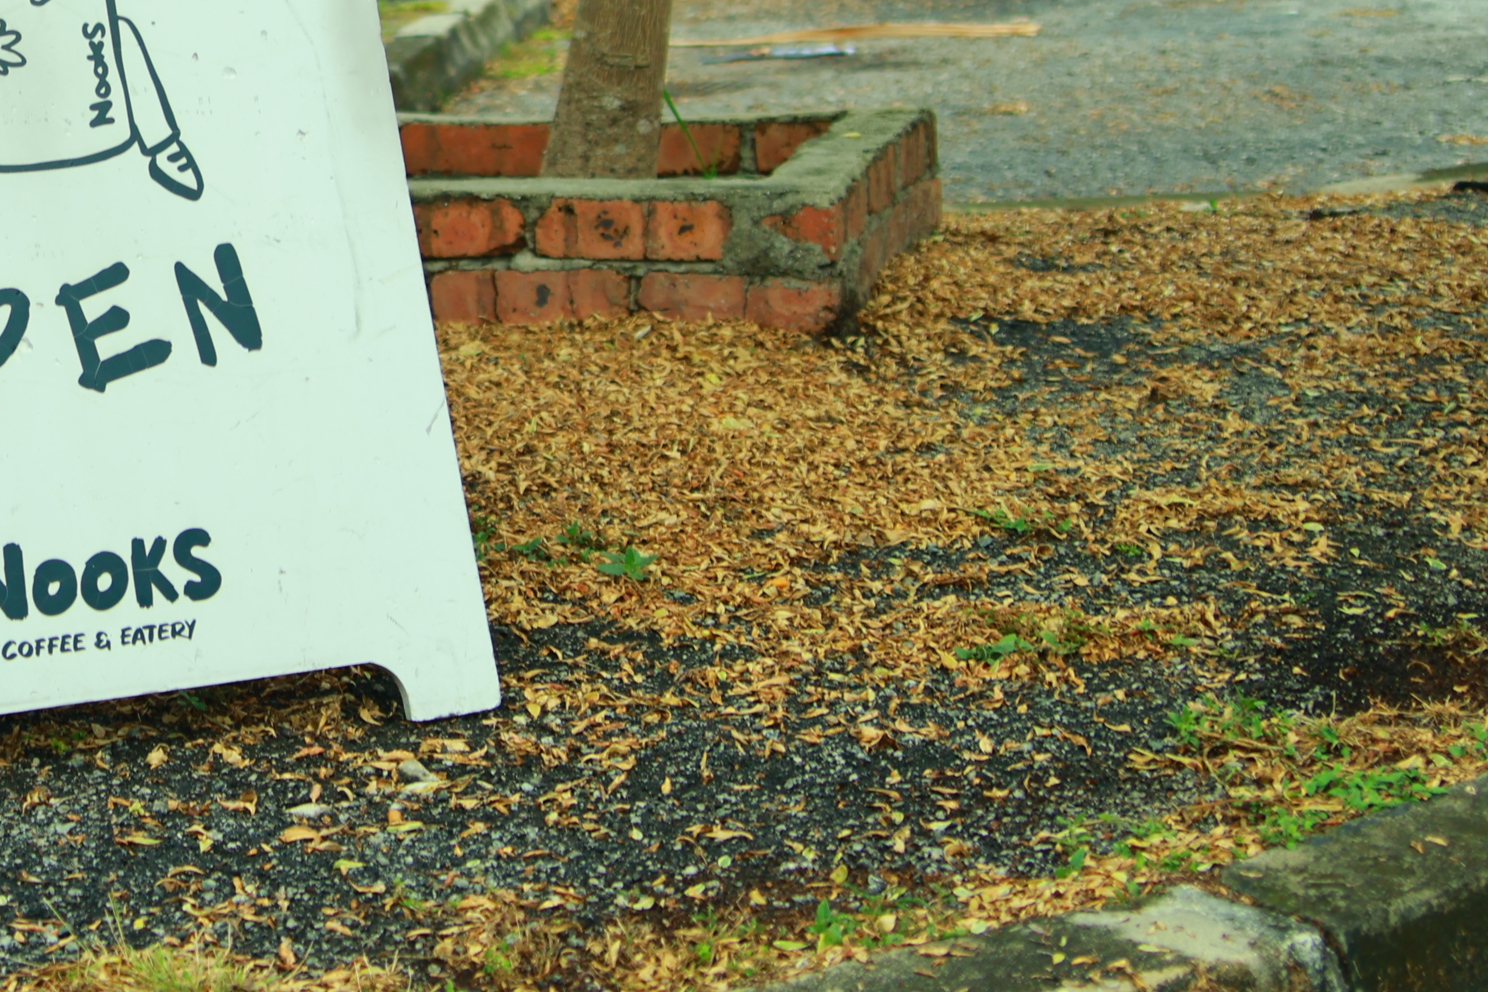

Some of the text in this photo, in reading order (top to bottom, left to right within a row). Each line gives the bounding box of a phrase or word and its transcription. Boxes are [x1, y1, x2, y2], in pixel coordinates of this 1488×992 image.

[1, 618, 197, 661] COFFEE & EATERY
